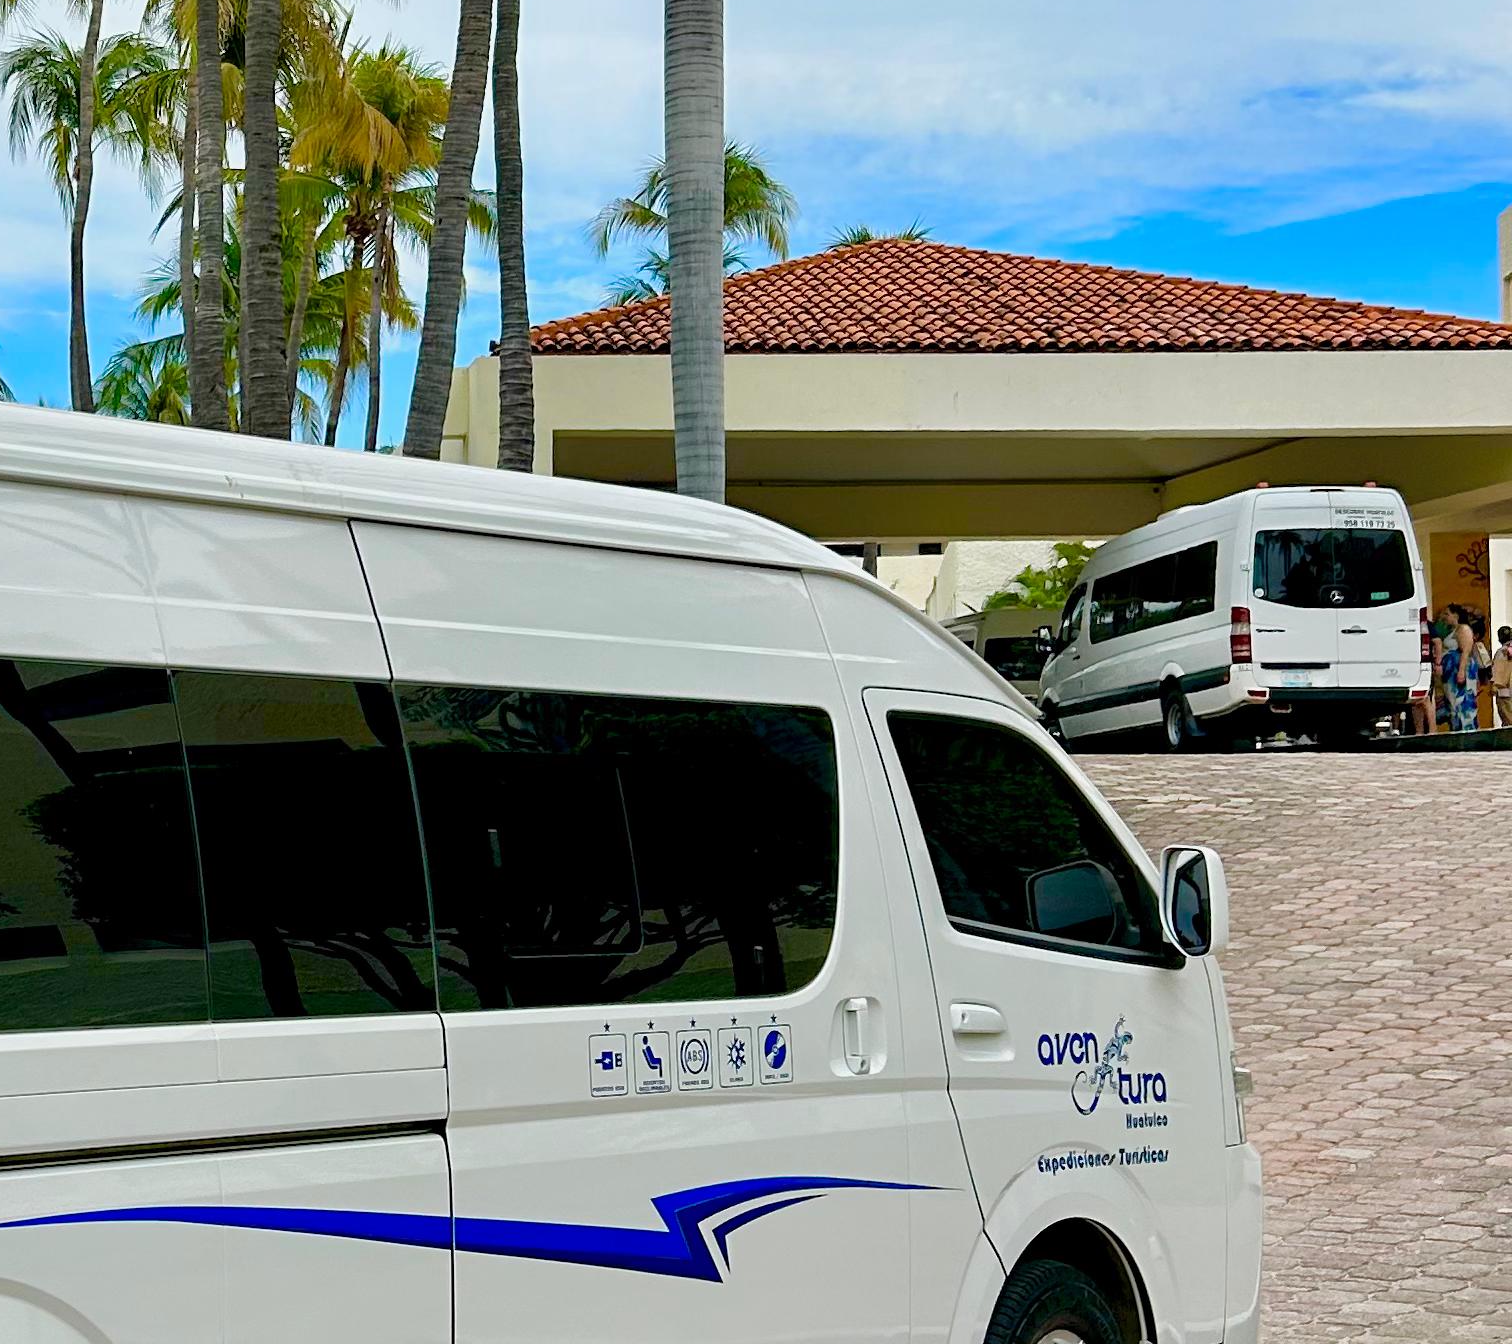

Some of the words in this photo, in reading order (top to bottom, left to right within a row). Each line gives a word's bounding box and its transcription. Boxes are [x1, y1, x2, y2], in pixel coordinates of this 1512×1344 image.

[687, 1049, 703, 1062] ABS
[1117, 1067, 1168, 1105] tura
[1126, 1111, 1168, 1129] Huatulco
[1037, 1149, 1117, 1176] Expediciones
